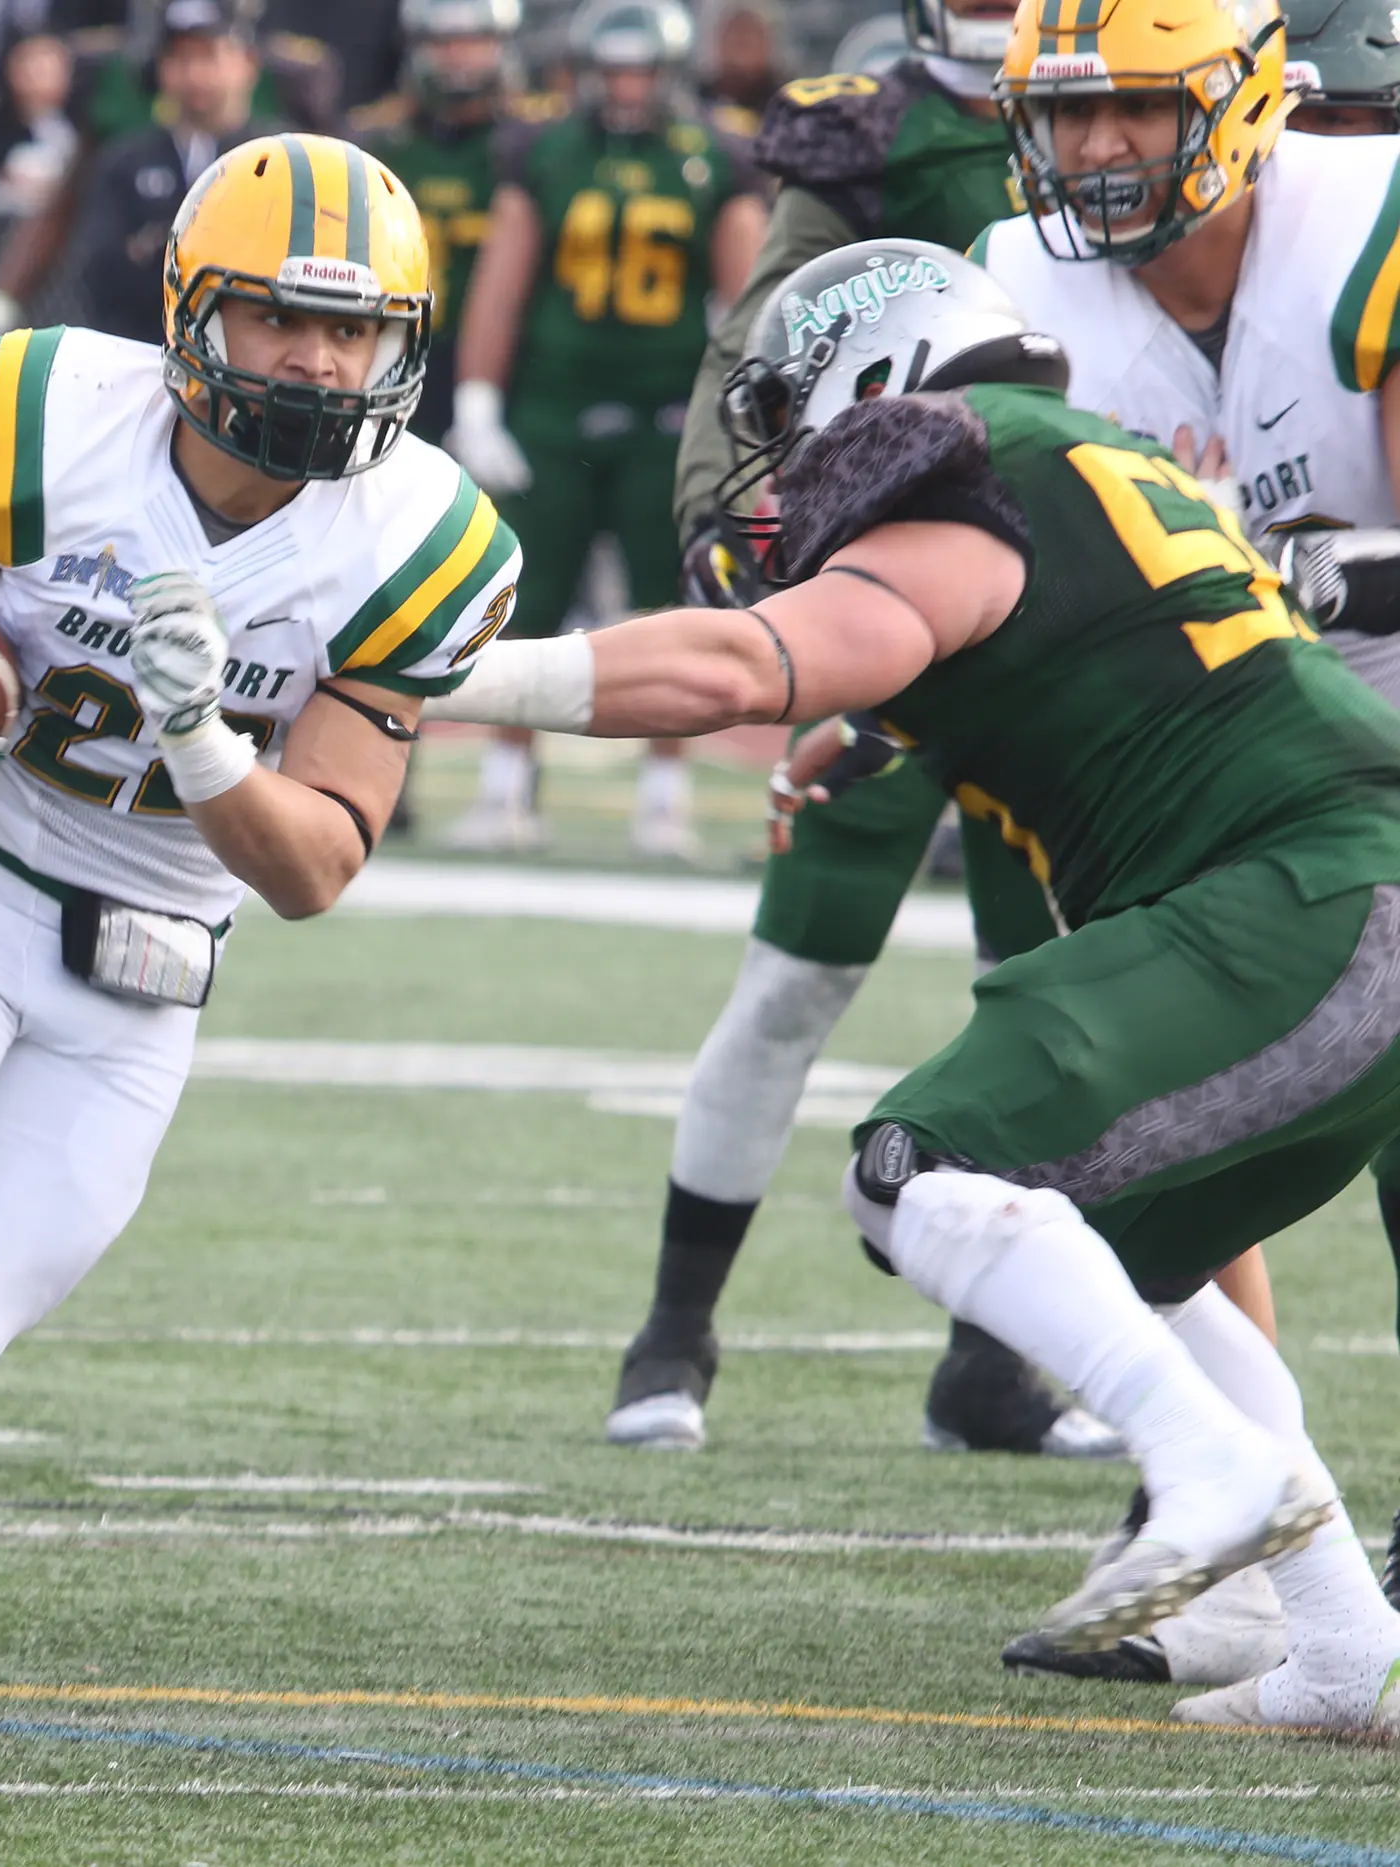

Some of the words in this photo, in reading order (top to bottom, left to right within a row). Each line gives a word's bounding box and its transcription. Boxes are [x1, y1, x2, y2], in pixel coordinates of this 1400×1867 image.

[302, 262, 357, 284] Riddell
[554, 190, 696, 327] 46
[781, 256, 952, 356] Aggies
[54, 605, 295, 700] BROORT
